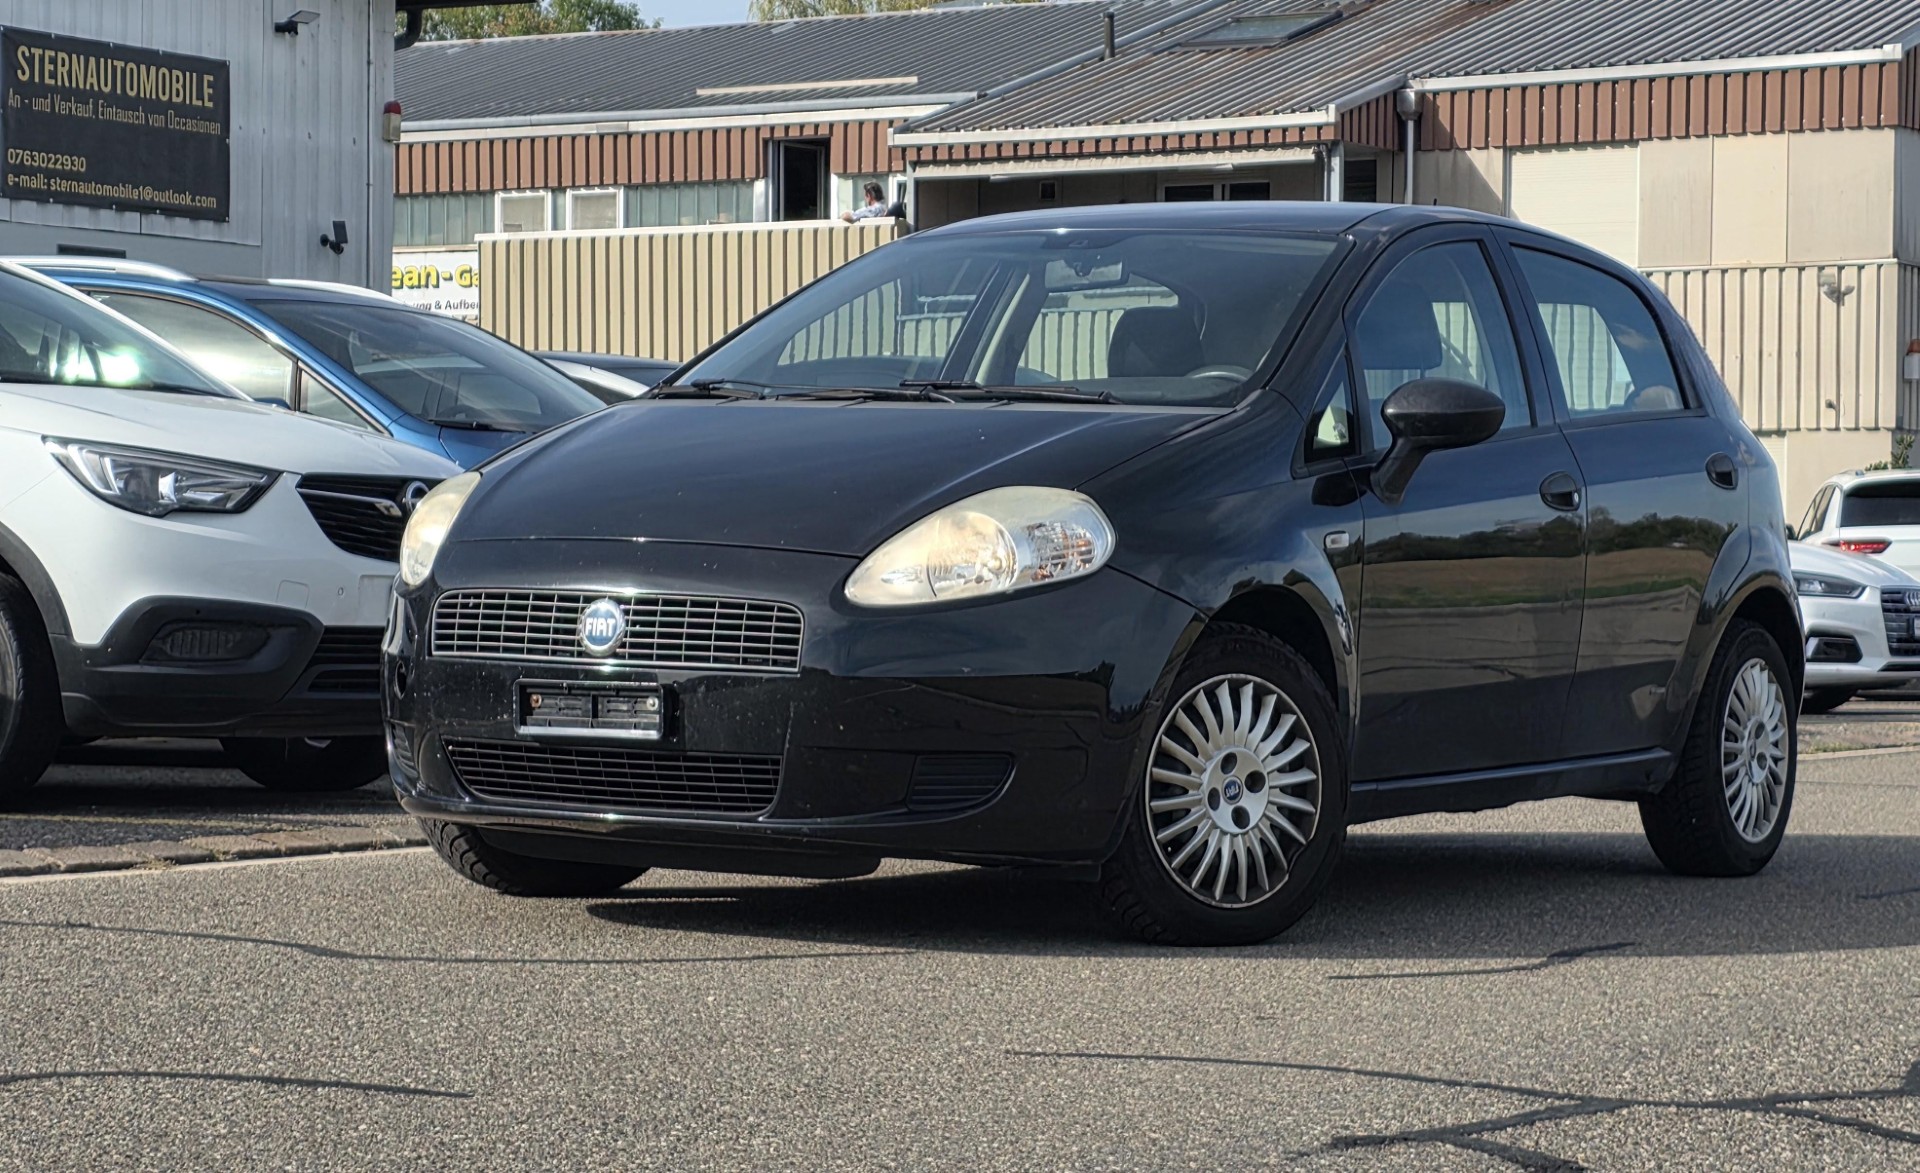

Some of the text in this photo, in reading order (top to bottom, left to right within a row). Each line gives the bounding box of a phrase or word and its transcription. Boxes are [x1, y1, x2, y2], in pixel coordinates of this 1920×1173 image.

[16, 45, 214, 108] STERNAUTOMOBILE
[8, 88, 21, 109] An
[32, 93, 51, 113] und
[98, 99, 145, 126] Eintausch
[148, 112, 165, 128] von
[167, 109, 221, 135] Occasionen
[7, 148, 87, 172] 0763022930
[7, 172, 217, 209] e-mail: sternautomobile1@outlook.com
[585, 617, 616, 637] FIAT
